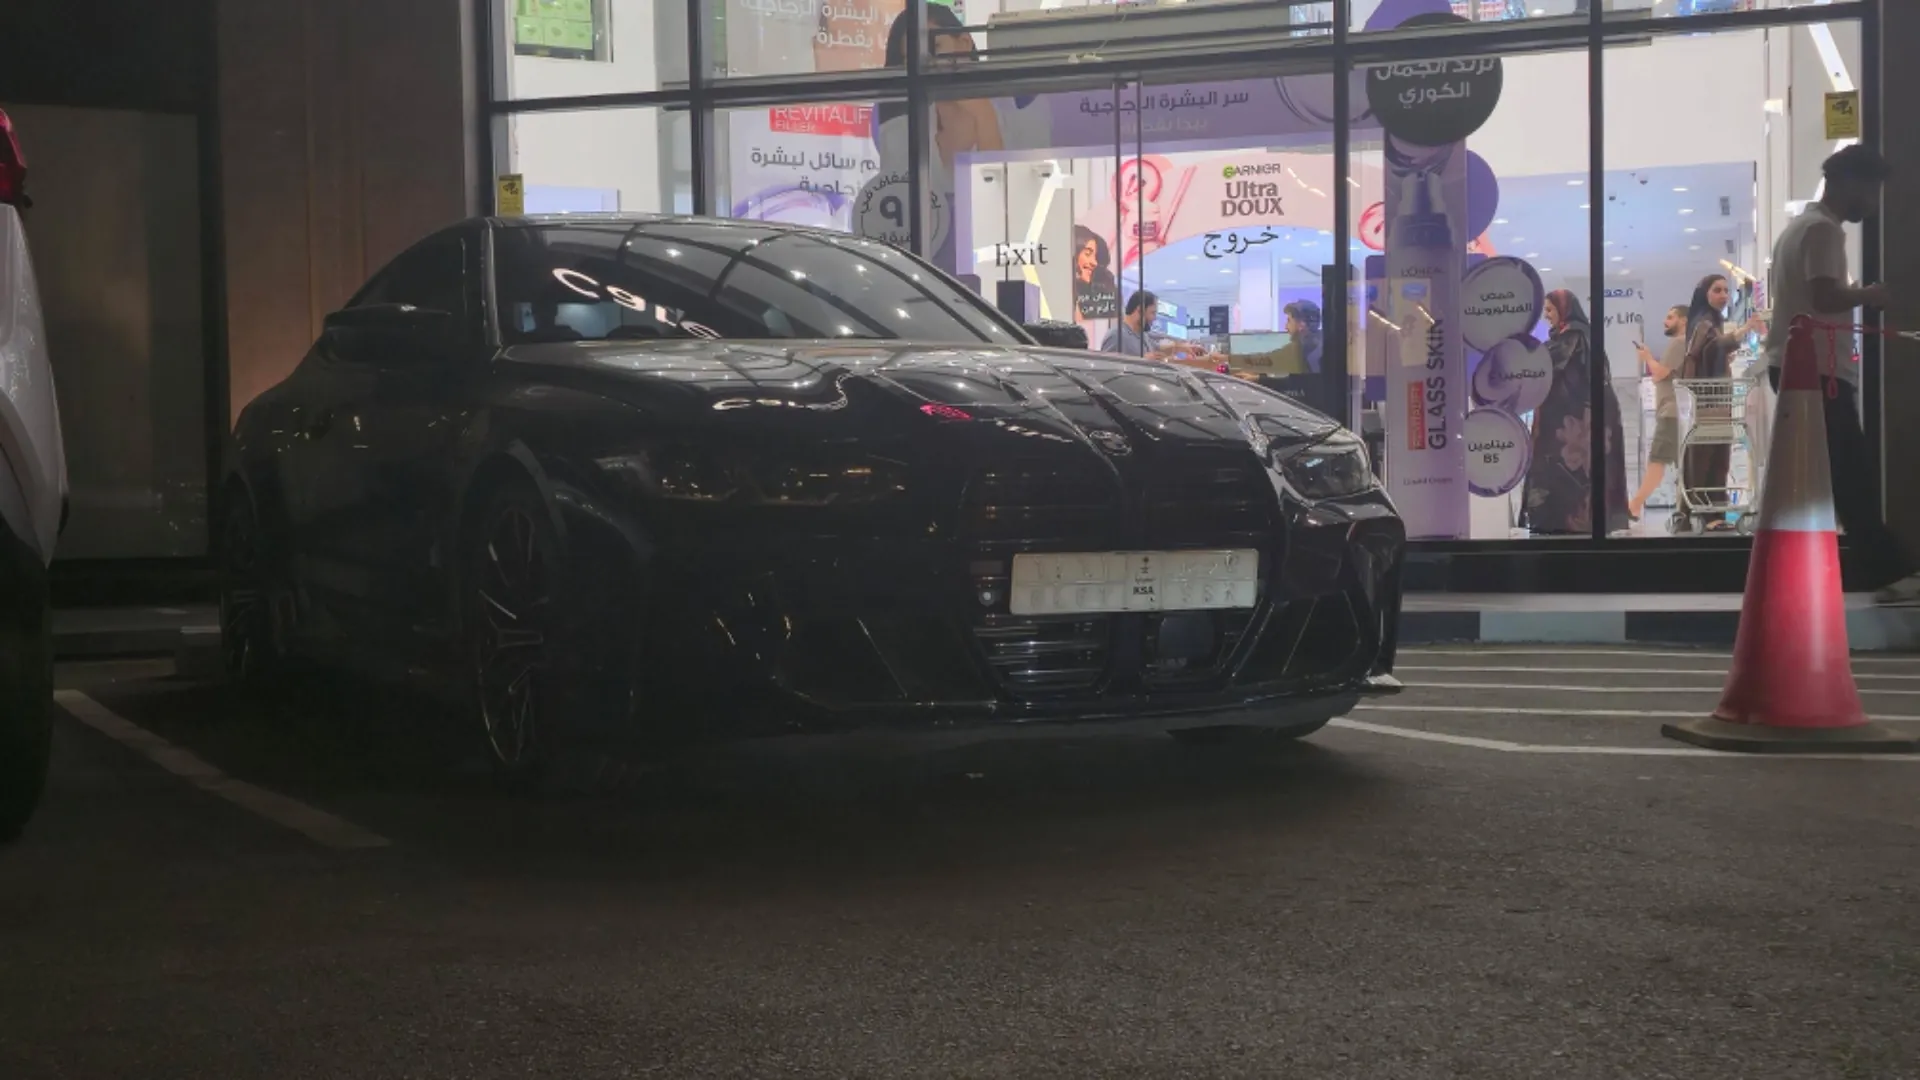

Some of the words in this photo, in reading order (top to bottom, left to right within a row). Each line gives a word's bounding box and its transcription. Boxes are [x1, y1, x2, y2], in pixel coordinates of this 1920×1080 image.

[1159, 89, 1218, 112] البشرة
[1222, 92, 1249, 108] سر
[1398, 80, 1471, 109] الكوري
[750, 146, 805, 170] لبشرة
[809, 152, 857, 171] سائل
[1223, 163, 1281, 179] GARNIER
[1225, 181, 1279, 199] Ultra
[1221, 197, 1285, 217] DOUX
[1203, 224, 1279, 260] خروج
[995, 242, 1049, 268] Exit
[1426, 318, 1445, 370] SKIN
[1428, 376, 1446, 450] GLASS
[1468, 439, 1516, 453] فيتامين
[1483, 453, 1501, 464] B5
[1132, 585, 1156, 595] KSA
